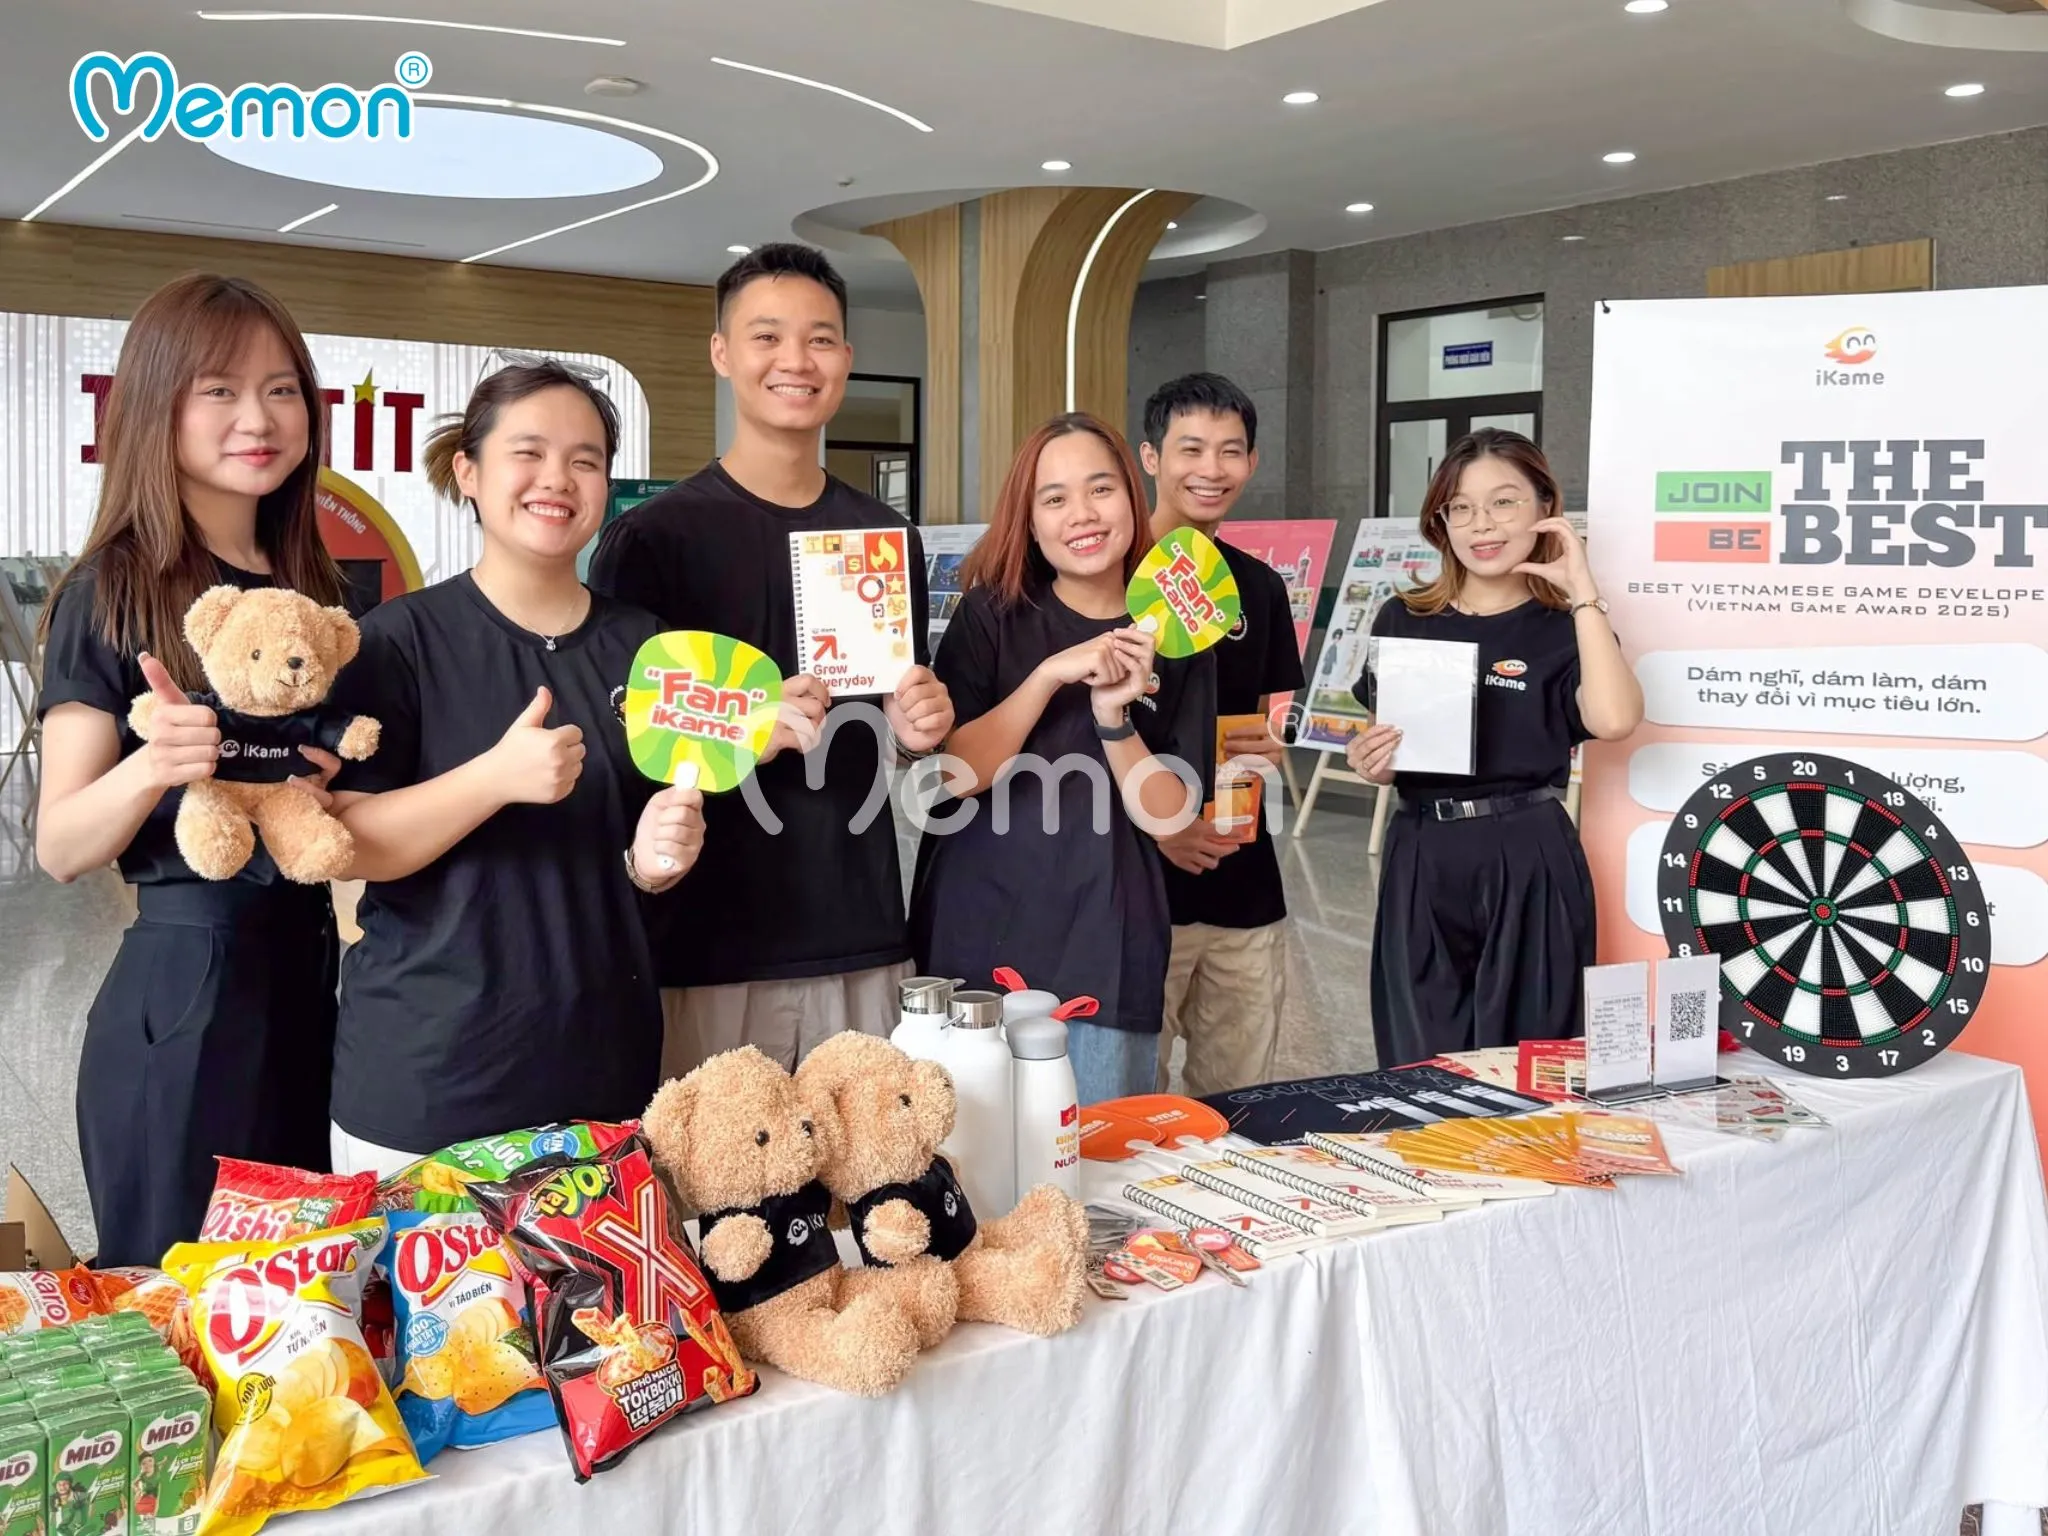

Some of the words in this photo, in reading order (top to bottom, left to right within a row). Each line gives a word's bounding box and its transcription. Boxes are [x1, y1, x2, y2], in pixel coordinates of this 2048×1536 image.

[1815, 369, 1885, 387] iKame
[1780, 438, 1985, 502] THE
[1667, 481, 1763, 505] JOIN
[1707, 529, 1762, 551] BE
[1779, 502, 2048, 568] BEST
[1627, 582, 1684, 594] BEST
[1691, 583, 1835, 598] VIETNAMESE
[1844, 586, 1908, 600] GAME
[1154, 569, 1200, 634] iKame
[1938, 604, 2010, 619] 2025)
[813, 664, 848, 676] Grow
[1687, 665, 1742, 684] Dám
[1749, 668, 1804, 688] nghĩ,
[1811, 670, 1865, 687] dám
[1872, 672, 1924, 692] làm,
[1931, 674, 1987, 691] dám
[817, 675, 875, 690] veryday
[1484, 674, 1527, 691] iKame
[1698, 687, 1748, 707] thay
[1755, 685, 1791, 707] đổi
[1797, 690, 1817, 708] vì
[1823, 695, 1876, 713] mục
[1882, 693, 1930, 713] tiêu
[1937, 695, 1981, 714] lớn.
[652, 705, 745, 741] iKame
[243, 742, 290, 759] iKame
[1753, 765, 1767, 781] 5
[1791, 760, 1818, 777] 20
[1844, 770, 1855, 785] 1
[1708, 784, 1733, 799] 12
[1882, 791, 1906, 807] 18
[1684, 814, 1699, 829] 9
[1924, 825, 1939, 841] 4
[1662, 853, 1687, 868] 14
[1947, 865, 1970, 882] 13
[1662, 897, 1684, 913] 11
[1966, 910, 1981, 927] 6
[1678, 943, 1692, 957] 8
[1961, 956, 1984, 974] 10
[1945, 998, 1970, 1015] 15
[1742, 1021, 1755, 1038] 7
[1922, 1029, 1936, 1047] 2
[1781, 1046, 1806, 1063] 19
[1835, 1054, 1850, 1071] 3
[1877, 1050, 1900, 1067] 17
[201, 1202, 289, 1240] Oishi
[398, 1224, 500, 1293] O'Sta
[209, 1241, 357, 1355] O'Star
[147, 1420, 195, 1446] MILO
[65, 1440, 116, 1467] MILO
[0, 1460, 31, 1483] ILO
